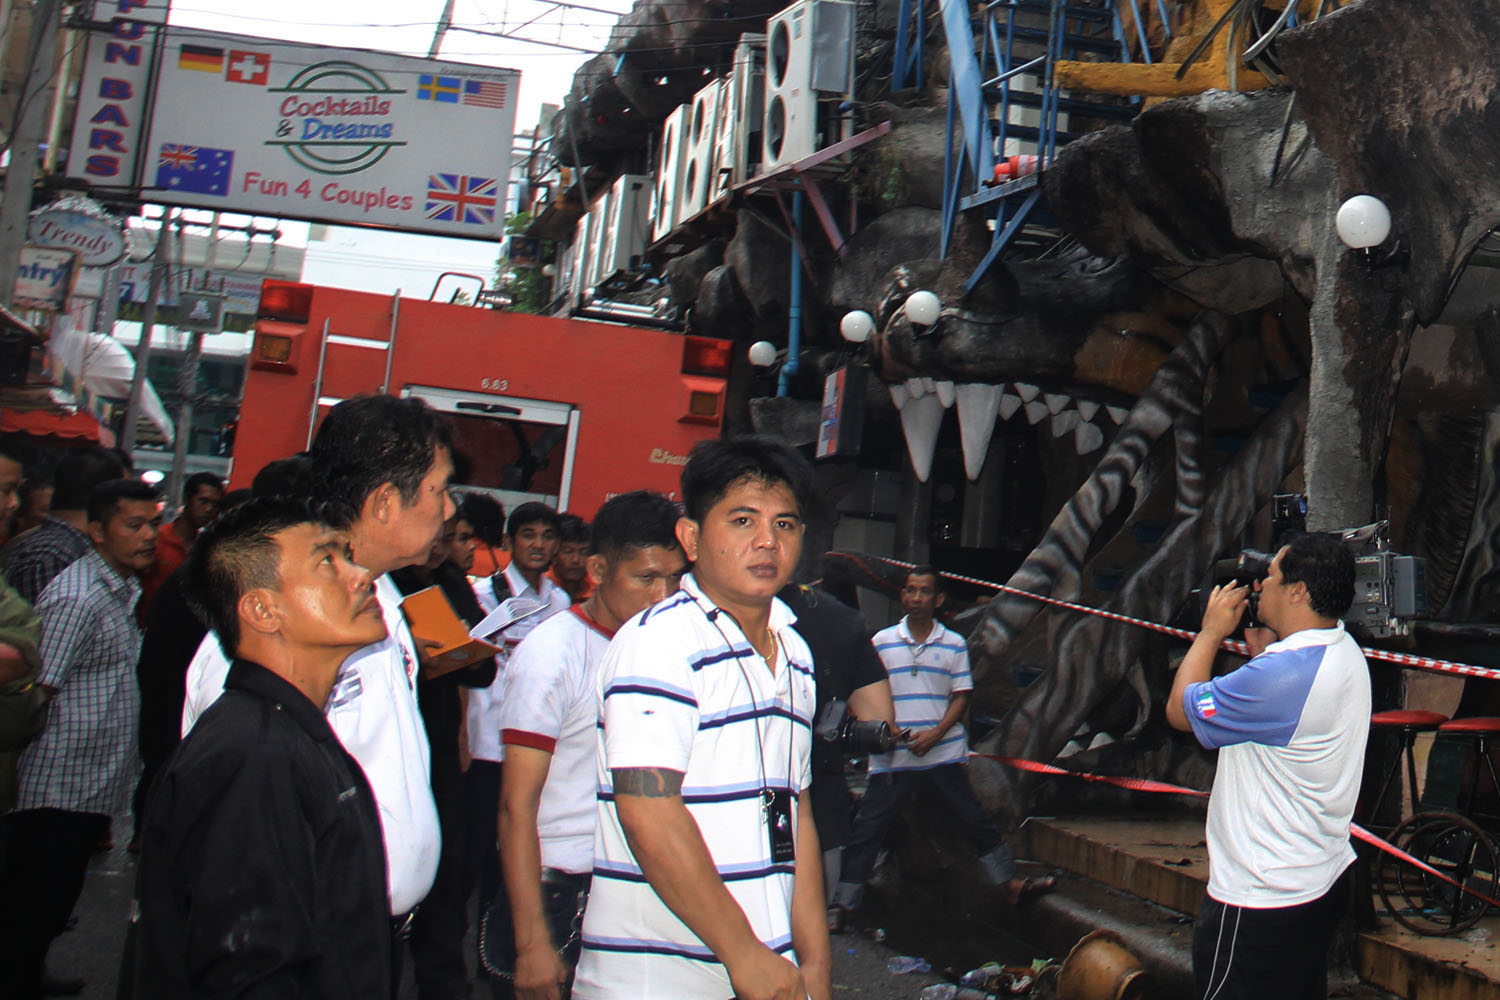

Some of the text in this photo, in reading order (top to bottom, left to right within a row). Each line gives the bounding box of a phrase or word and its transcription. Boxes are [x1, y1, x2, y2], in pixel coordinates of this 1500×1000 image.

[280, 95, 392, 117] Cocktails
[85, 77, 134, 177] BARS
[274, 117, 393, 140] & Dreams
[243, 171, 413, 212] Fun 4 Couples
[40, 221, 113, 254] Trendy
